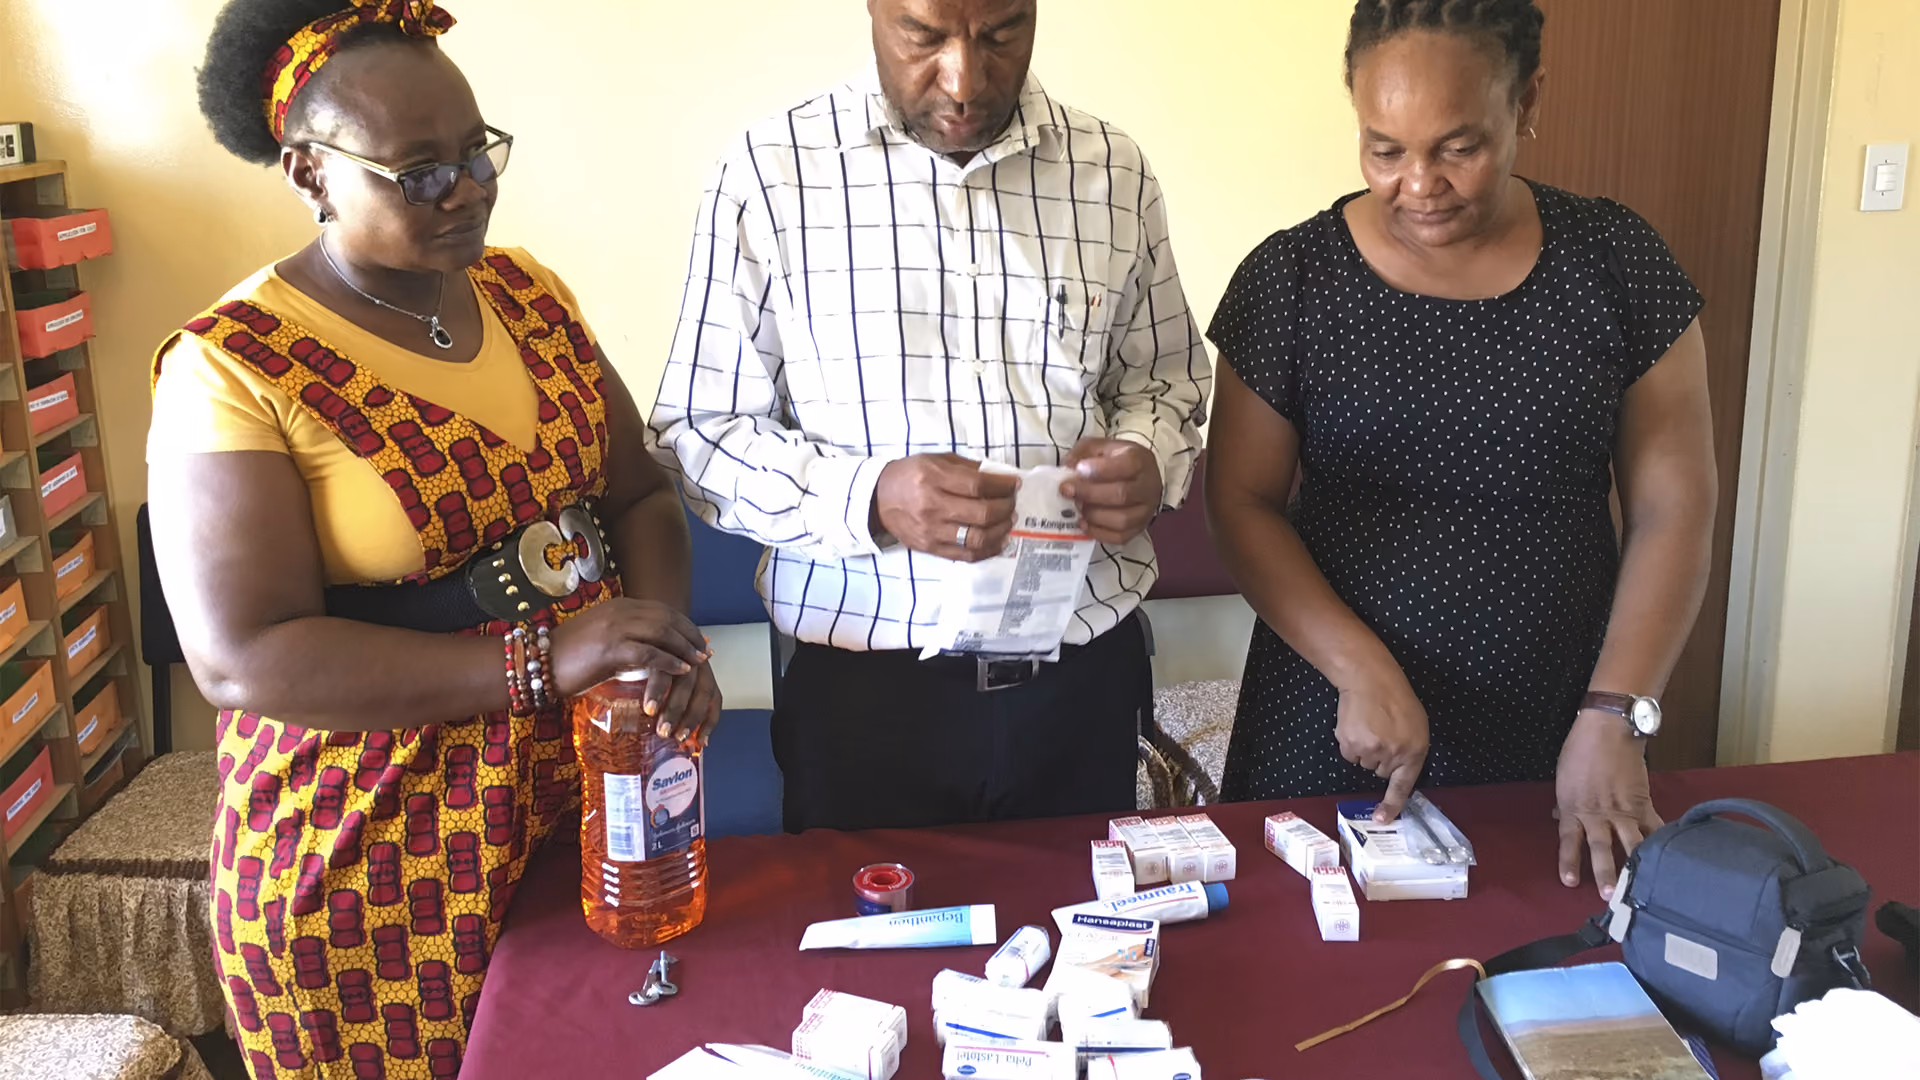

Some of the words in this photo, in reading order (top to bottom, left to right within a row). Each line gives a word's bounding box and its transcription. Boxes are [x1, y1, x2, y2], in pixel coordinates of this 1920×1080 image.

[652, 768, 692, 791] Savlon
[1111, 883, 1196, 912] Traumeel
[889, 912, 964, 926] Bepanthen
[1077, 916, 1148, 930] Hansaplast
